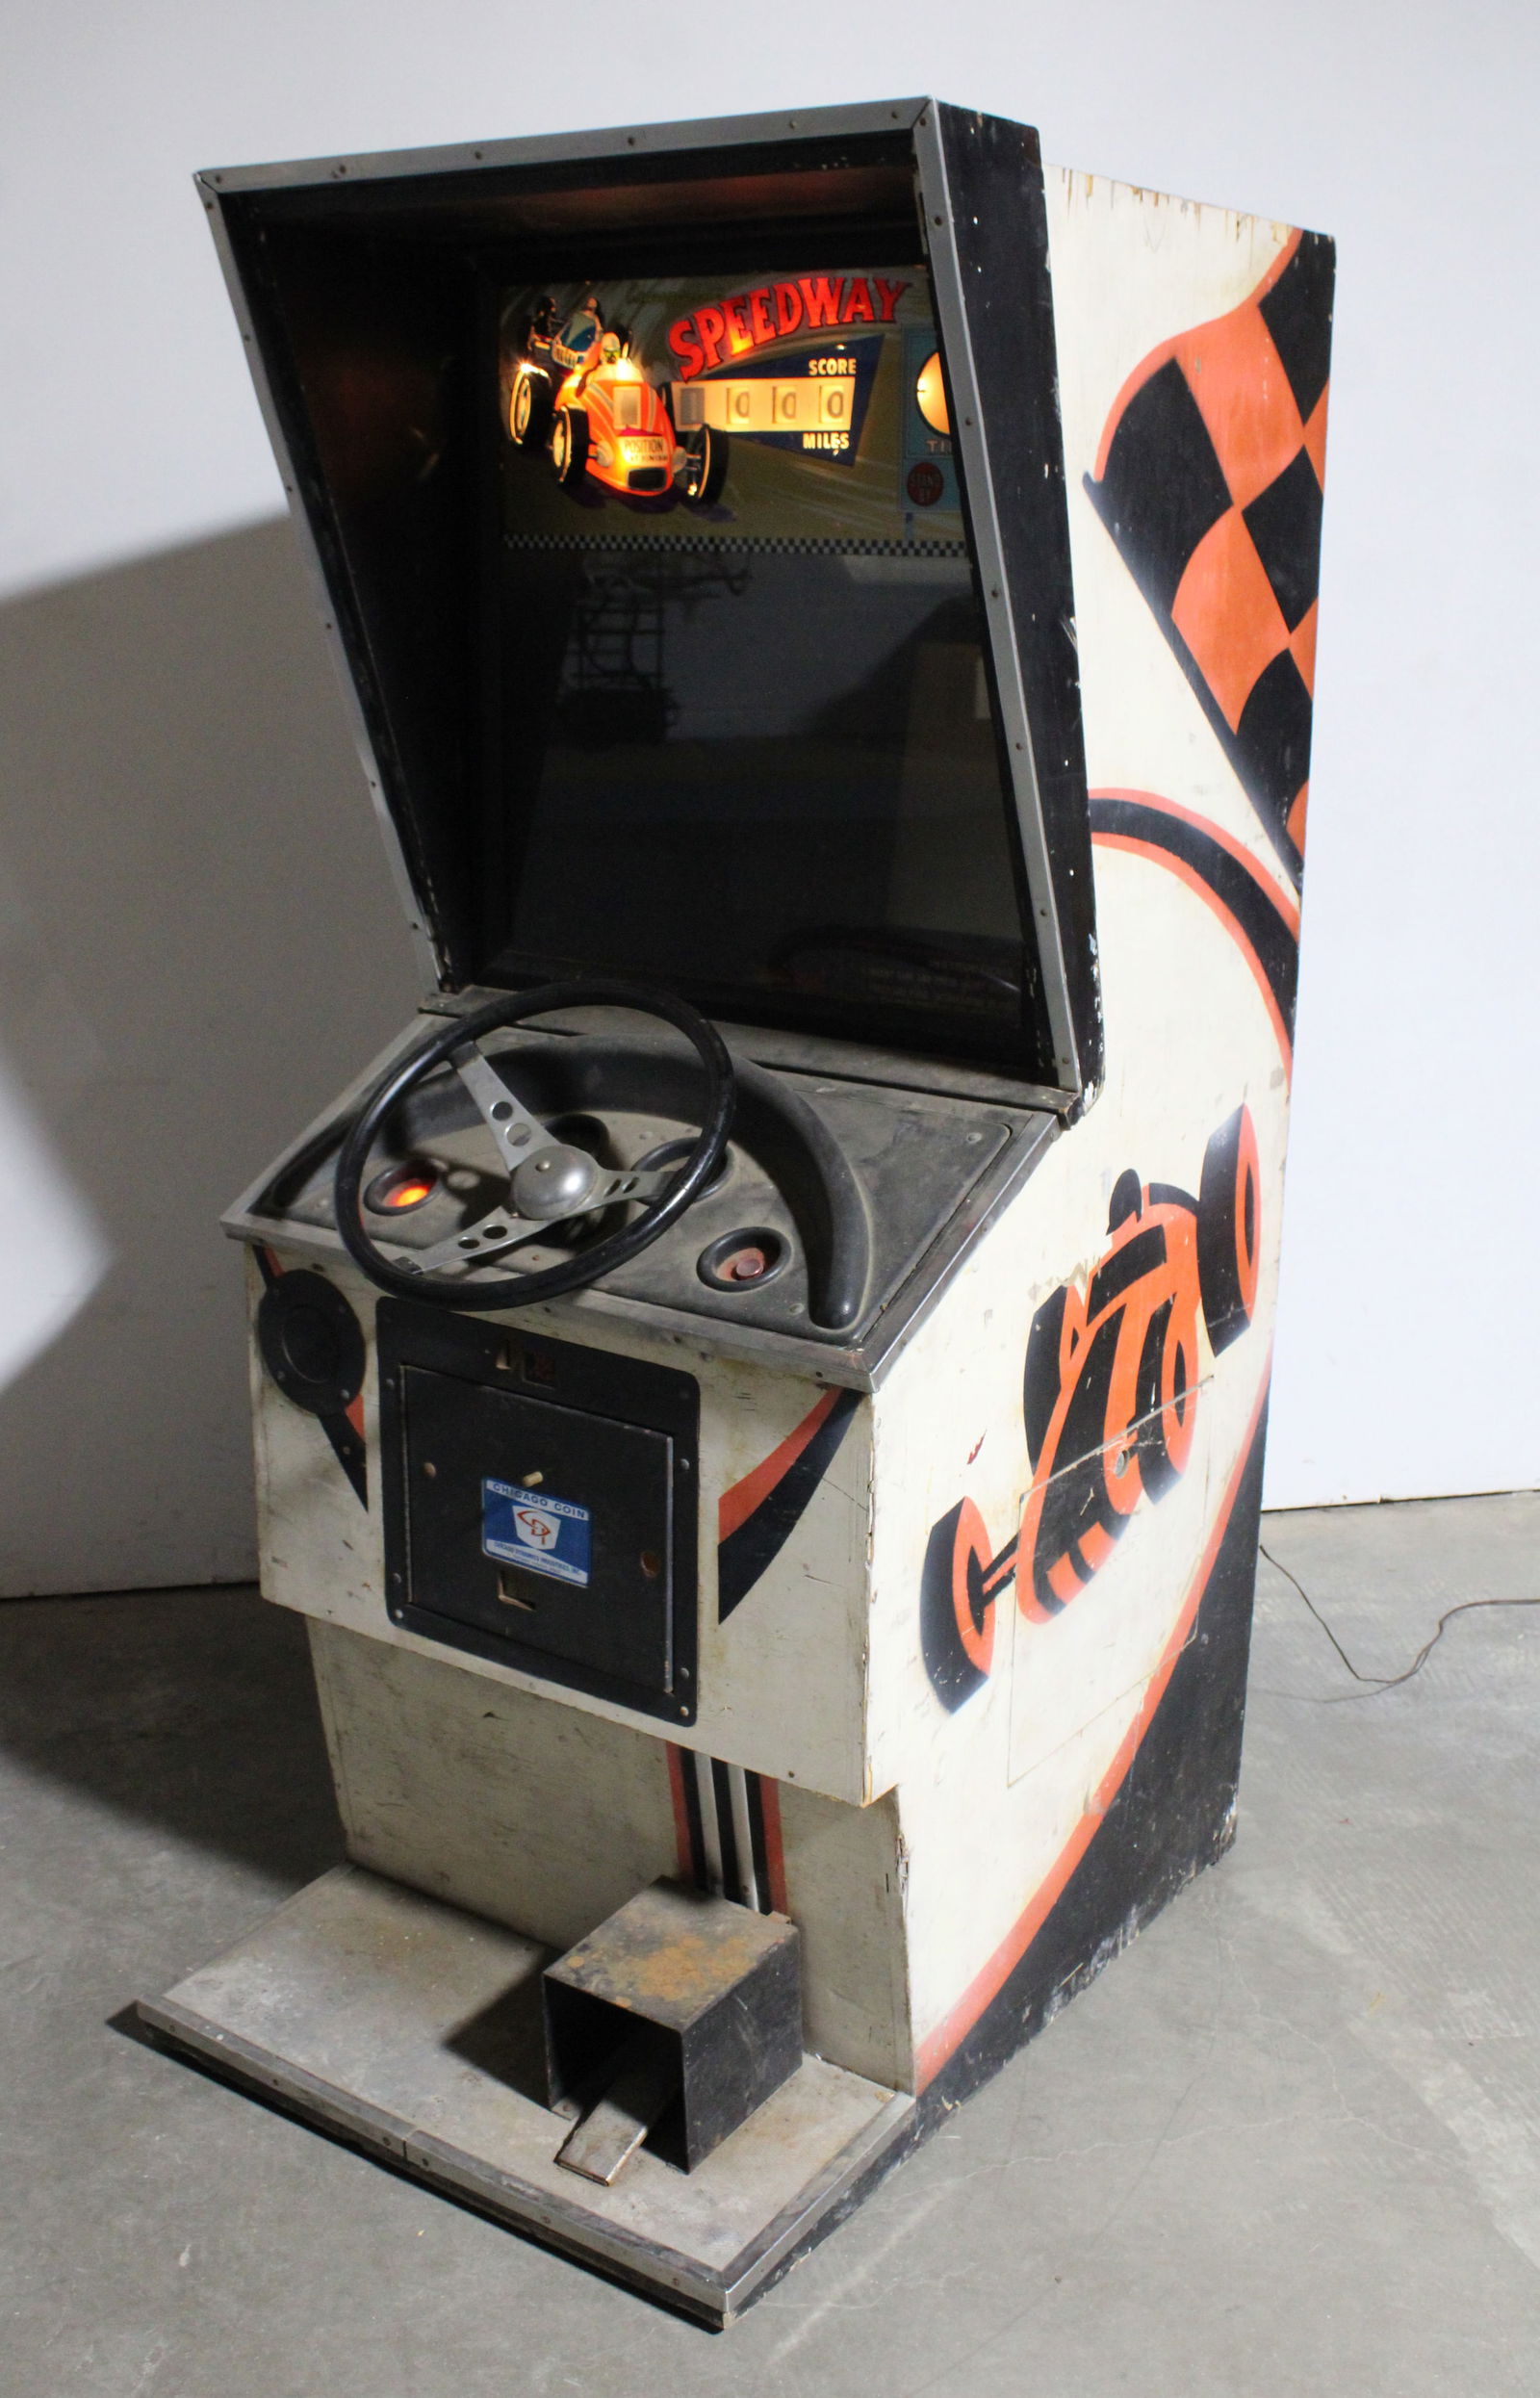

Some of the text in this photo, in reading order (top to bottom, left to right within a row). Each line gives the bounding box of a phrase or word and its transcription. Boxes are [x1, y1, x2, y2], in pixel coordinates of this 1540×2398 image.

[668, 276, 913, 382] SPEEDWAY
[808, 357, 858, 375] SCORE
[624, 438, 664, 453] POSITION
[802, 431, 850, 450] MILES
[493, 1483, 585, 1518] CHICAGO COIN
